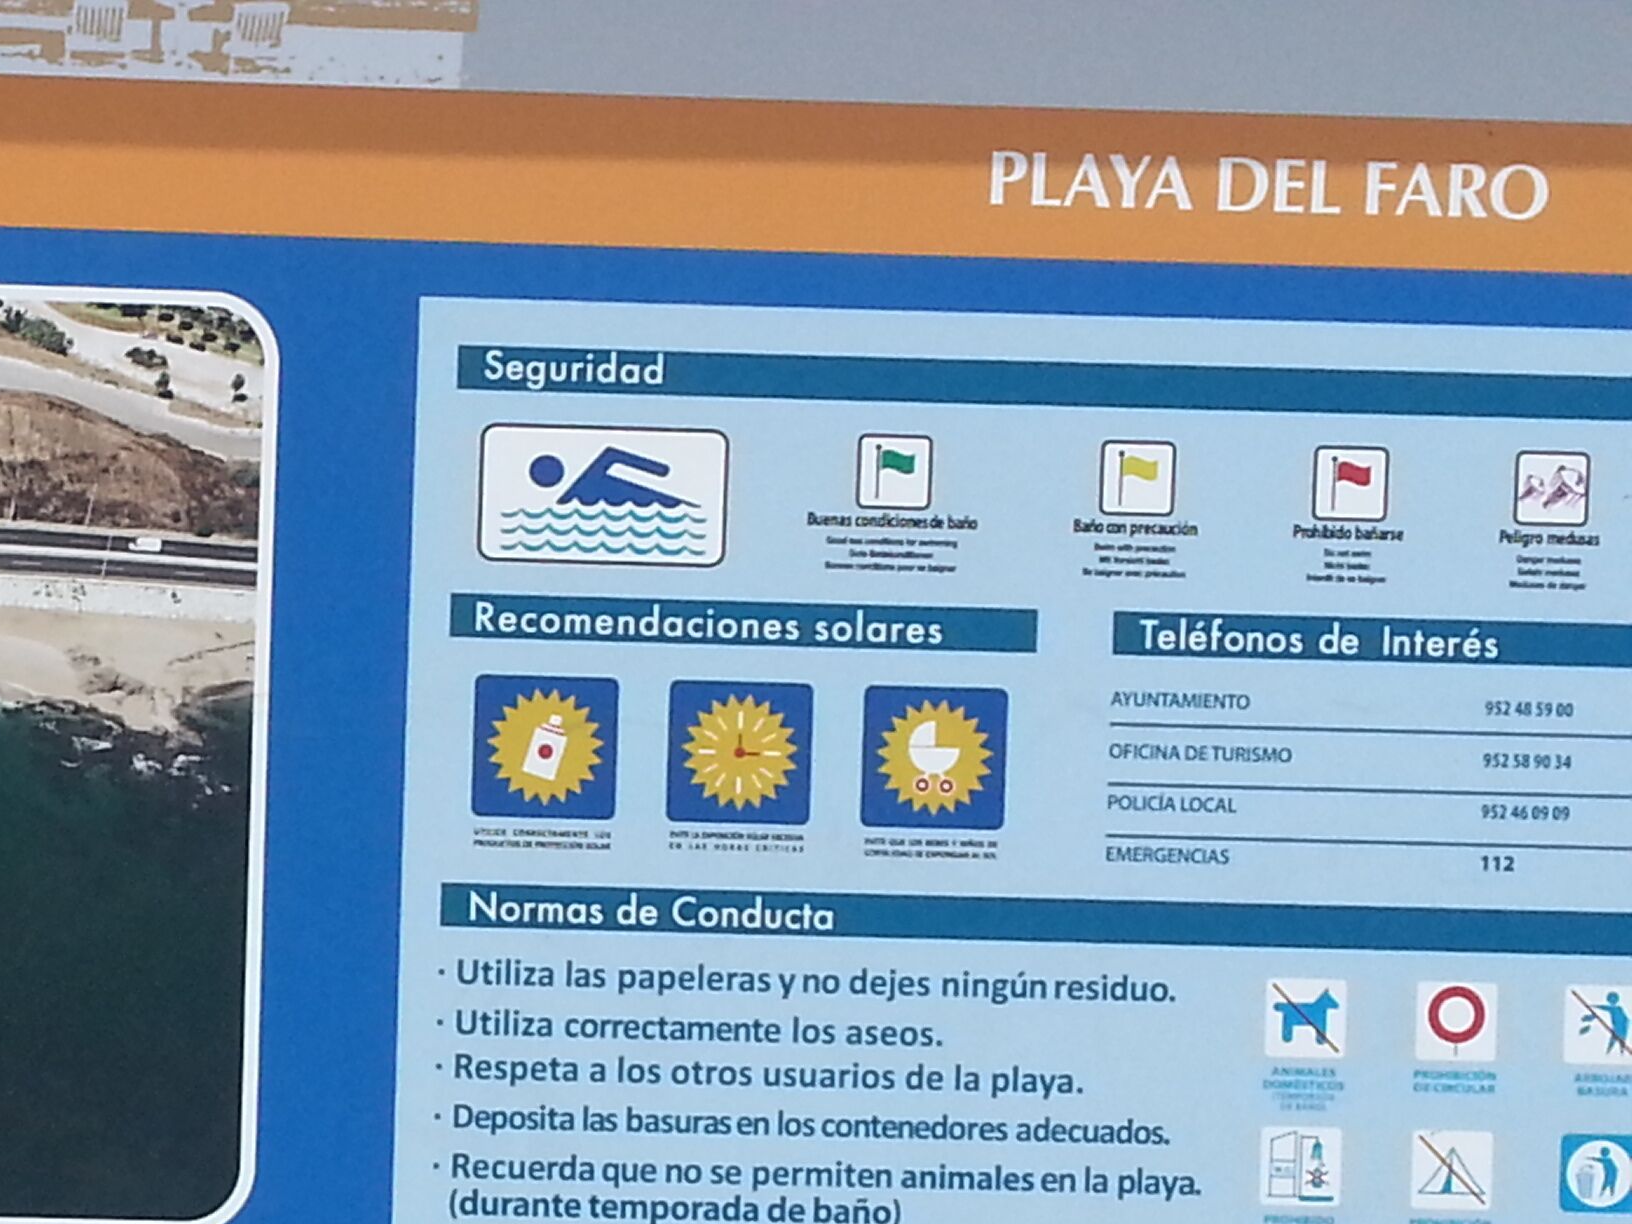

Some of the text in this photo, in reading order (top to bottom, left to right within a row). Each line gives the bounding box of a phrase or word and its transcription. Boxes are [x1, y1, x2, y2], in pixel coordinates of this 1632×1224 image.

[989, 151, 1548, 220] PLAYA DEL FARO
[484, 351, 664, 389] Seguridad
[475, 601, 942, 644] Recomendaciones solares
[1139, 617, 1498, 658] Teléfonos de Interés
[1110, 691, 1250, 710] AYUNTAMIENTO
[1108, 743, 1292, 763] OFICINA DE TURISMO
[1107, 794, 1237, 813] POLICÍA LOCAL
[1105, 846, 1229, 864] EMERGENCIAS
[1481, 855, 1514, 872] 112
[469, 890, 833, 930] Normas de Conducta
[457, 958, 1175, 1005] Utiliza las papeleras y no dejes ningún residuo.
[456, 1008, 942, 1046] Utiliza correctamente los aseos.
[449, 1188, 581, 1219] (durante
[767, 1195, 805, 1223] de
